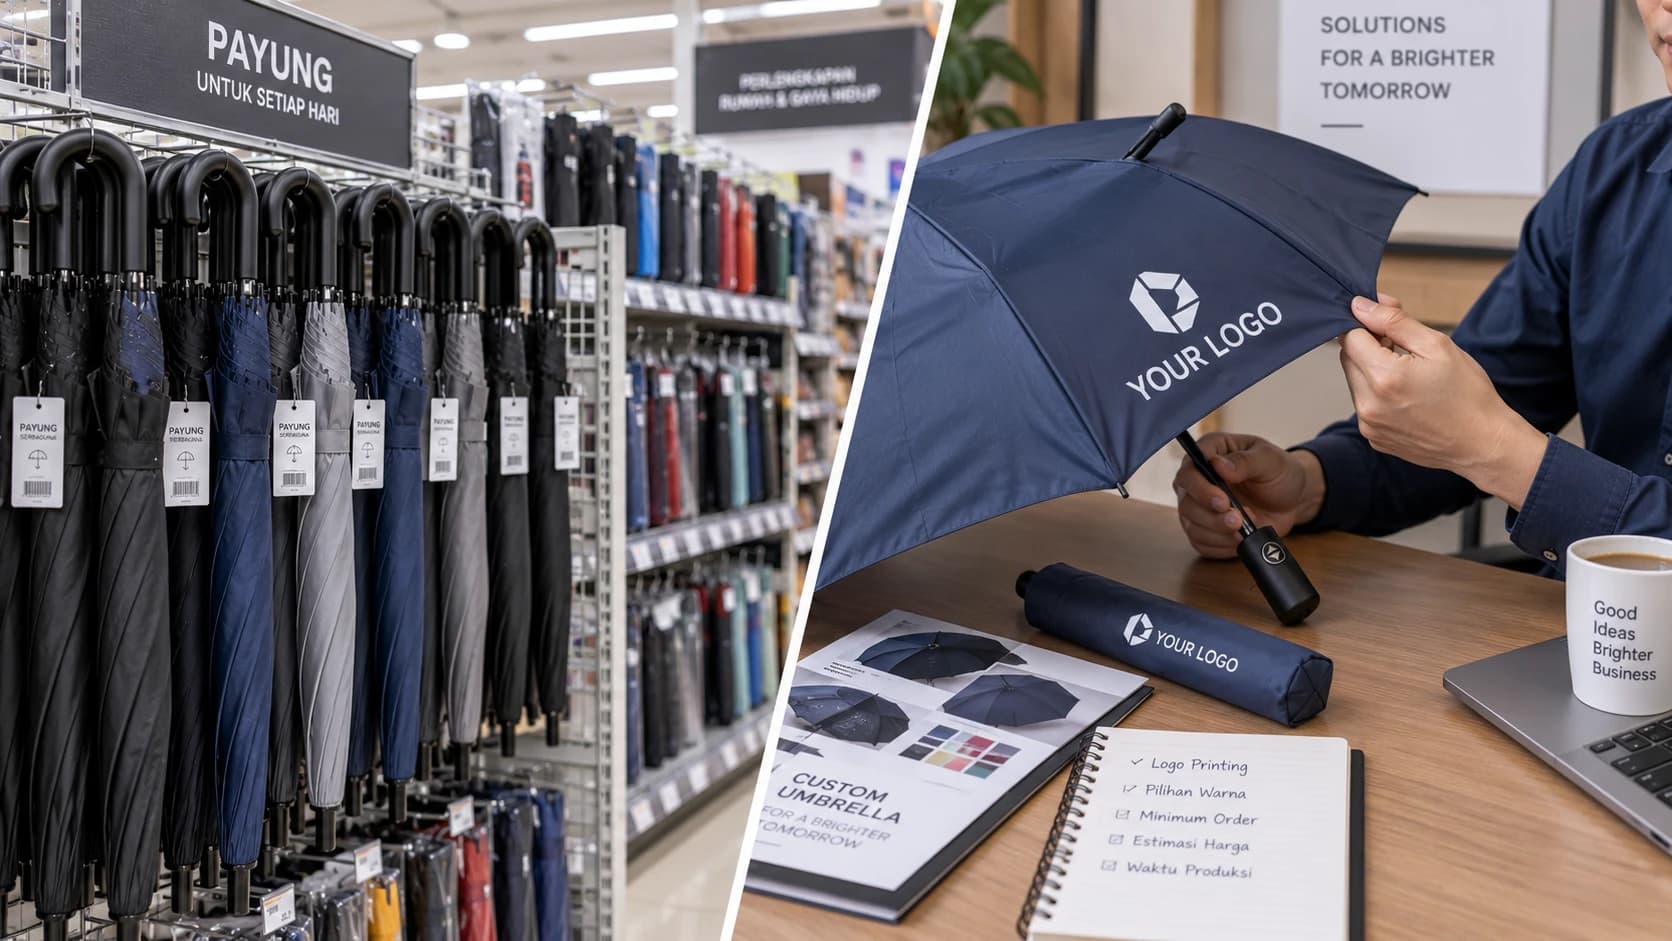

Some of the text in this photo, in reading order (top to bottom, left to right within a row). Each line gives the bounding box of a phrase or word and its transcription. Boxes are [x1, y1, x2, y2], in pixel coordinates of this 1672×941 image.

[1320, 16, 1446, 34] SOLUTIONS
[208, 20, 333, 94] PAYUNG
[1320, 49, 1496, 67] FOR A BRIGHTER
[197, 70, 340, 126] UNTUK SETIAP HARI
[1320, 82, 1451, 100] TOMORROW
[1125, 302, 1283, 401] YOUR LOGO
[19, 423, 57, 433] PAYUNG
[169, 426, 204, 435] PAYUNG
[278, 423, 311, 431] PAYUNG
[1594, 600, 1638, 621] Good
[1593, 620, 1636, 641] Ideas
[1156, 630, 1239, 672] YOUR LOGO
[1593, 641, 1654, 663] Brighter
[1592, 661, 1657, 681] Business
[1151, 758, 1248, 776] Logo Printing
[793, 772, 889, 803] CUSTOM
[1145, 784, 1247, 799] Pilihan Warna
[777, 786, 901, 824] UMBRELLA
[761, 804, 891, 841] FOR A BRIGHTER
[1139, 810, 1259, 825] Minimum Order
[1132, 835, 1250, 855] Estimasi Harga
[1127, 861, 1253, 879] Waktu Produksi
